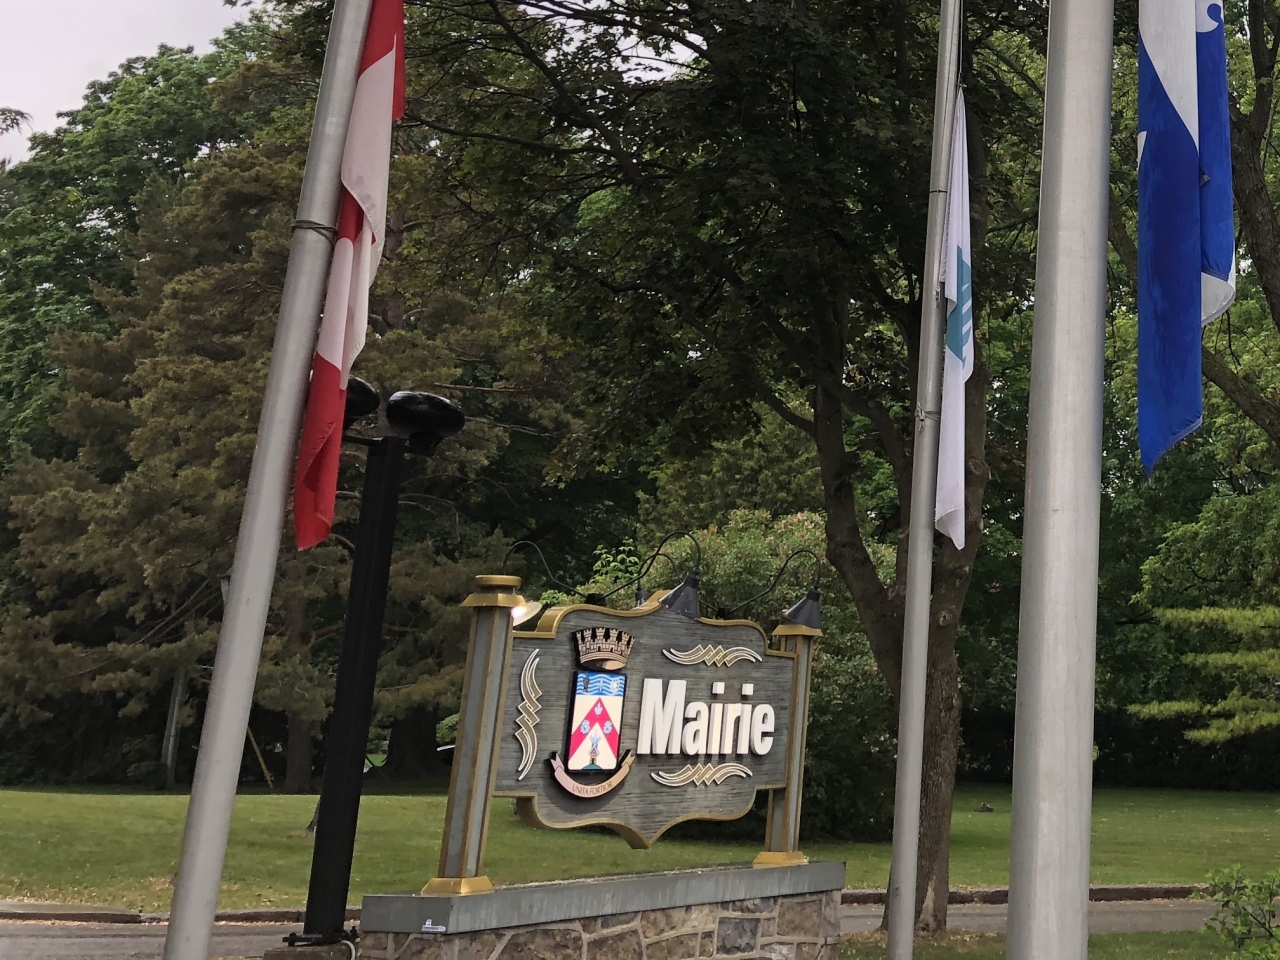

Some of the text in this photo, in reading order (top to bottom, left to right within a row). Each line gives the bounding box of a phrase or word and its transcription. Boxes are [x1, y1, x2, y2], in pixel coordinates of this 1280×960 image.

[637, 678, 775, 756] Mairie
[572, 780, 613, 795] UNITA FORTIOR
